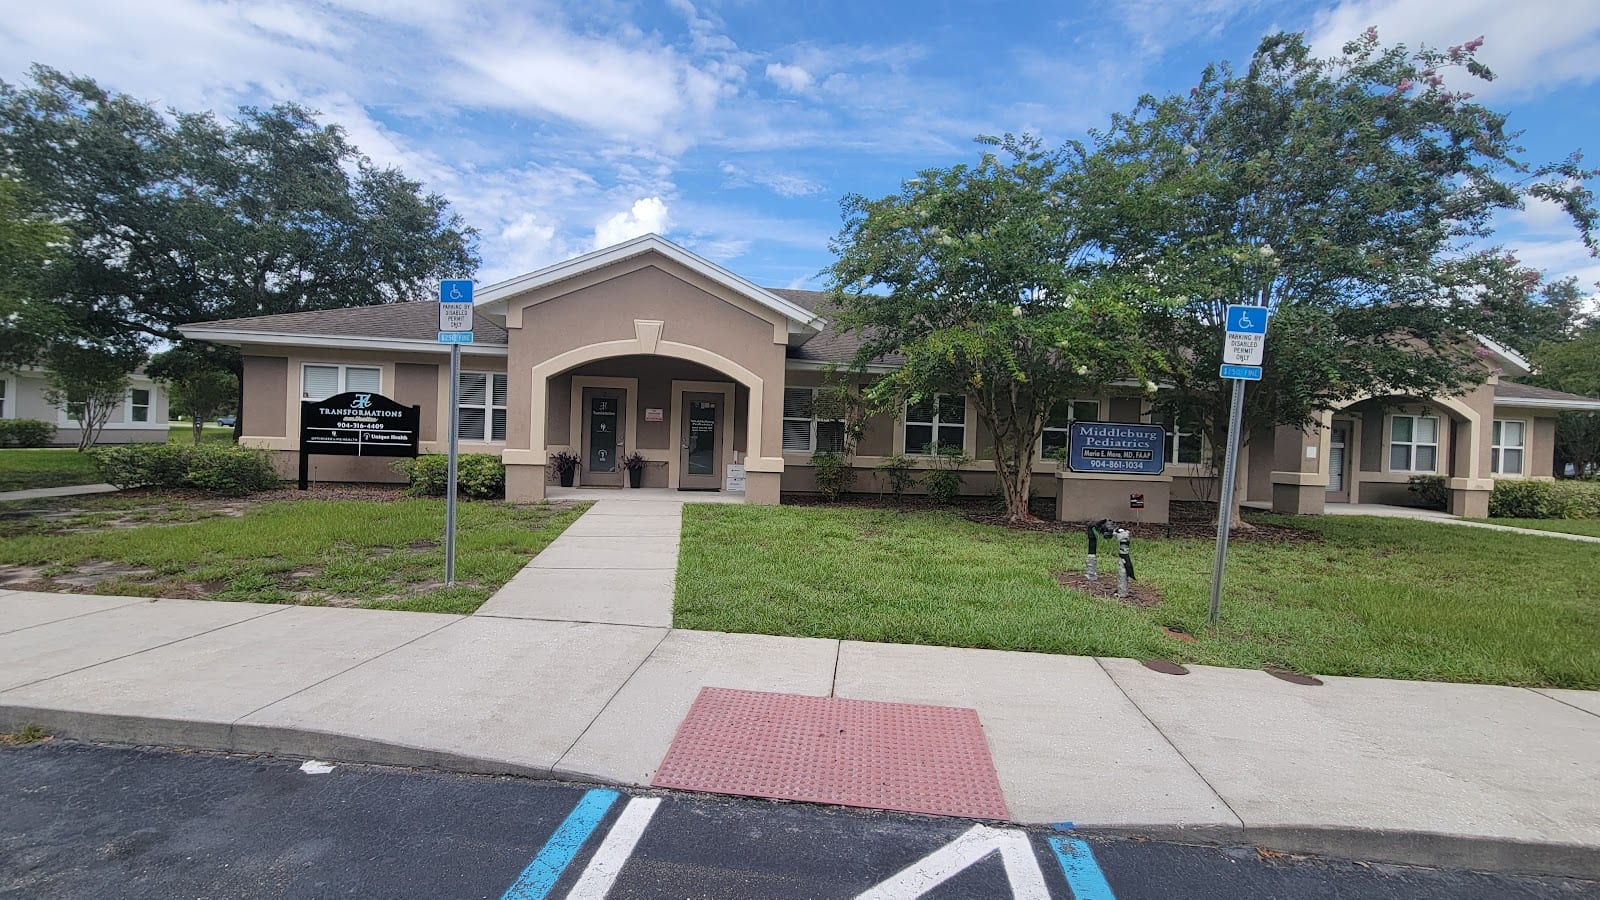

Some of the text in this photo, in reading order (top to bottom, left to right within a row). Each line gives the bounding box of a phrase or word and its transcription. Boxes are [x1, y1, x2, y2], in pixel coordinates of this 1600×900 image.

[319, 408, 403, 418] TRANSFORMATIONS
[336, 422, 384, 430] 904-316-4409
[371, 433, 390, 441] Unique
[1079, 426, 1157, 441] Middleburg
[1086, 437, 1150, 448] Pediatrics
[1090, 460, 1144, 469] 904-861-1034
